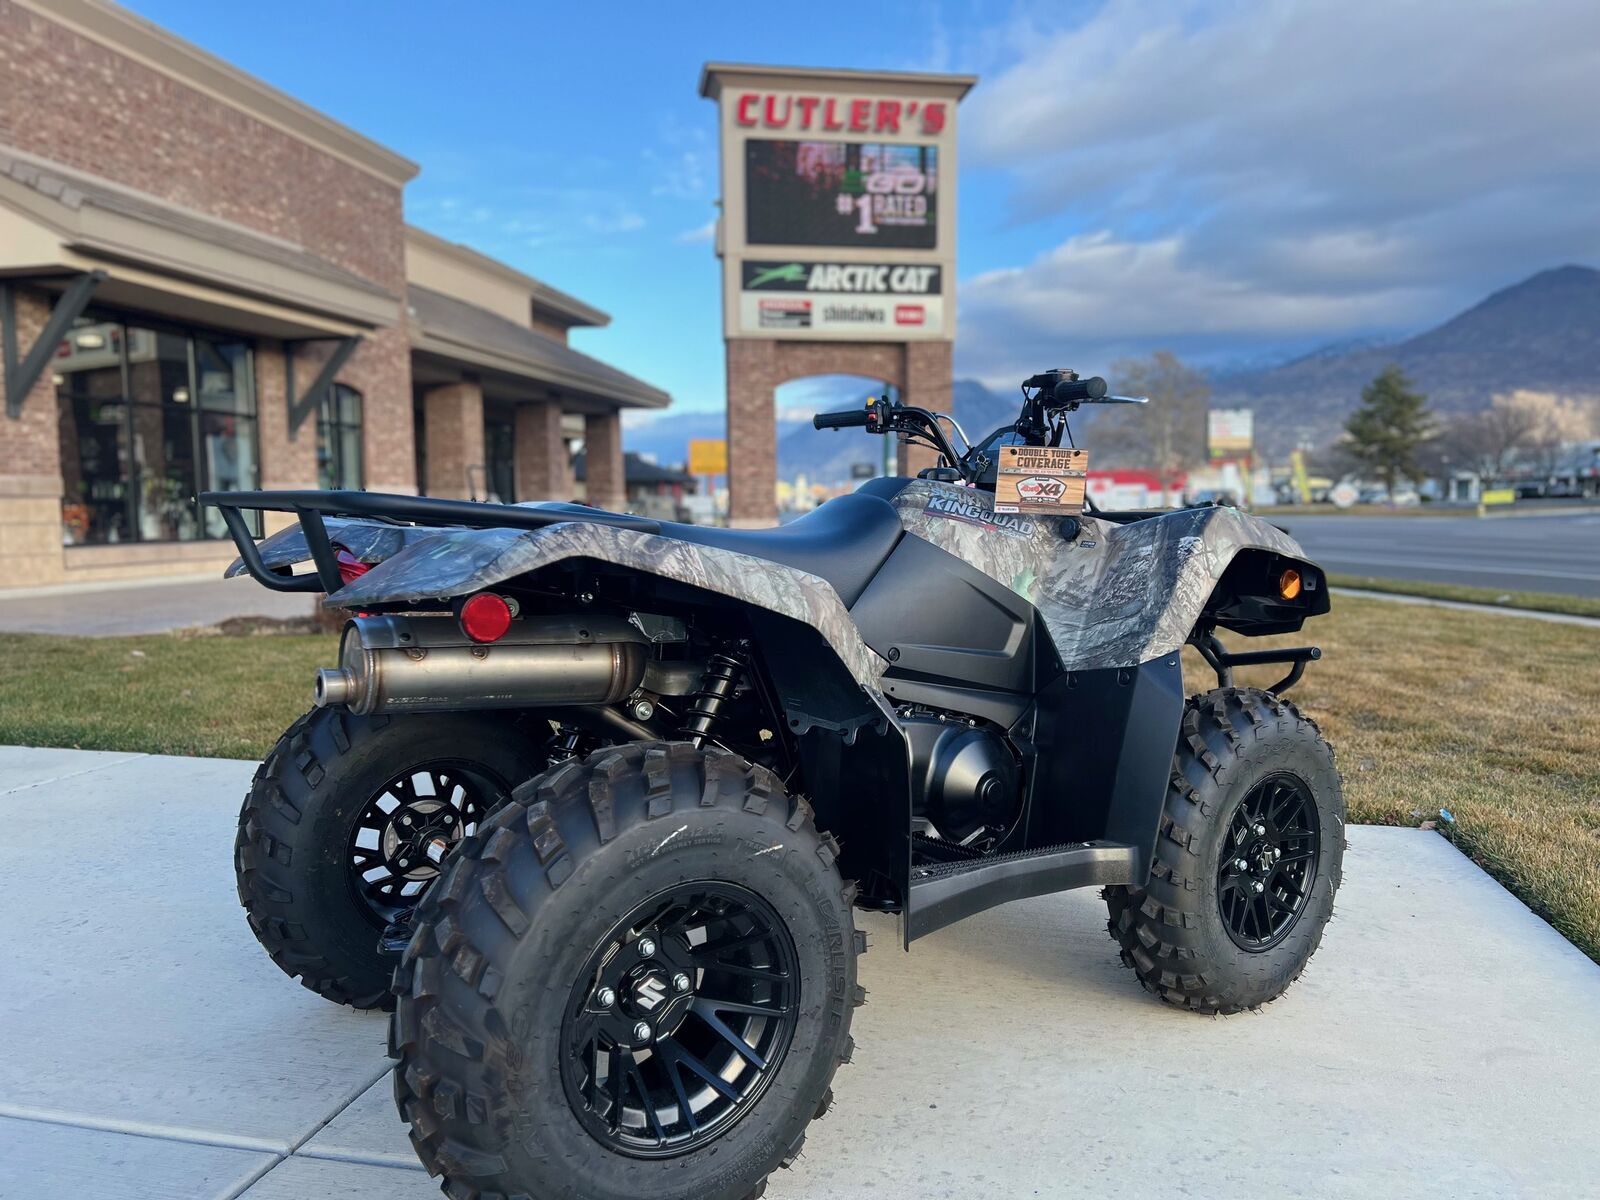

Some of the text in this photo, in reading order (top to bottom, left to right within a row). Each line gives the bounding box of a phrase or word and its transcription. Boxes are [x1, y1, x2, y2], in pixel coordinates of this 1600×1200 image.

[737, 93, 946, 134] CUTLER'S
[874, 195, 927, 216] RATED
[807, 264, 937, 292] ARCTIC CAT
[1016, 457, 1071, 469] COVERAGE
[1018, 448, 1072, 458] DOUBLE YOUR
[931, 488, 983, 508] SUZUKI
[928, 497, 1034, 535] KINGQUAD
[694, 837, 721, 846] SERVICE
[818, 899, 846, 1026] CARLISLE
